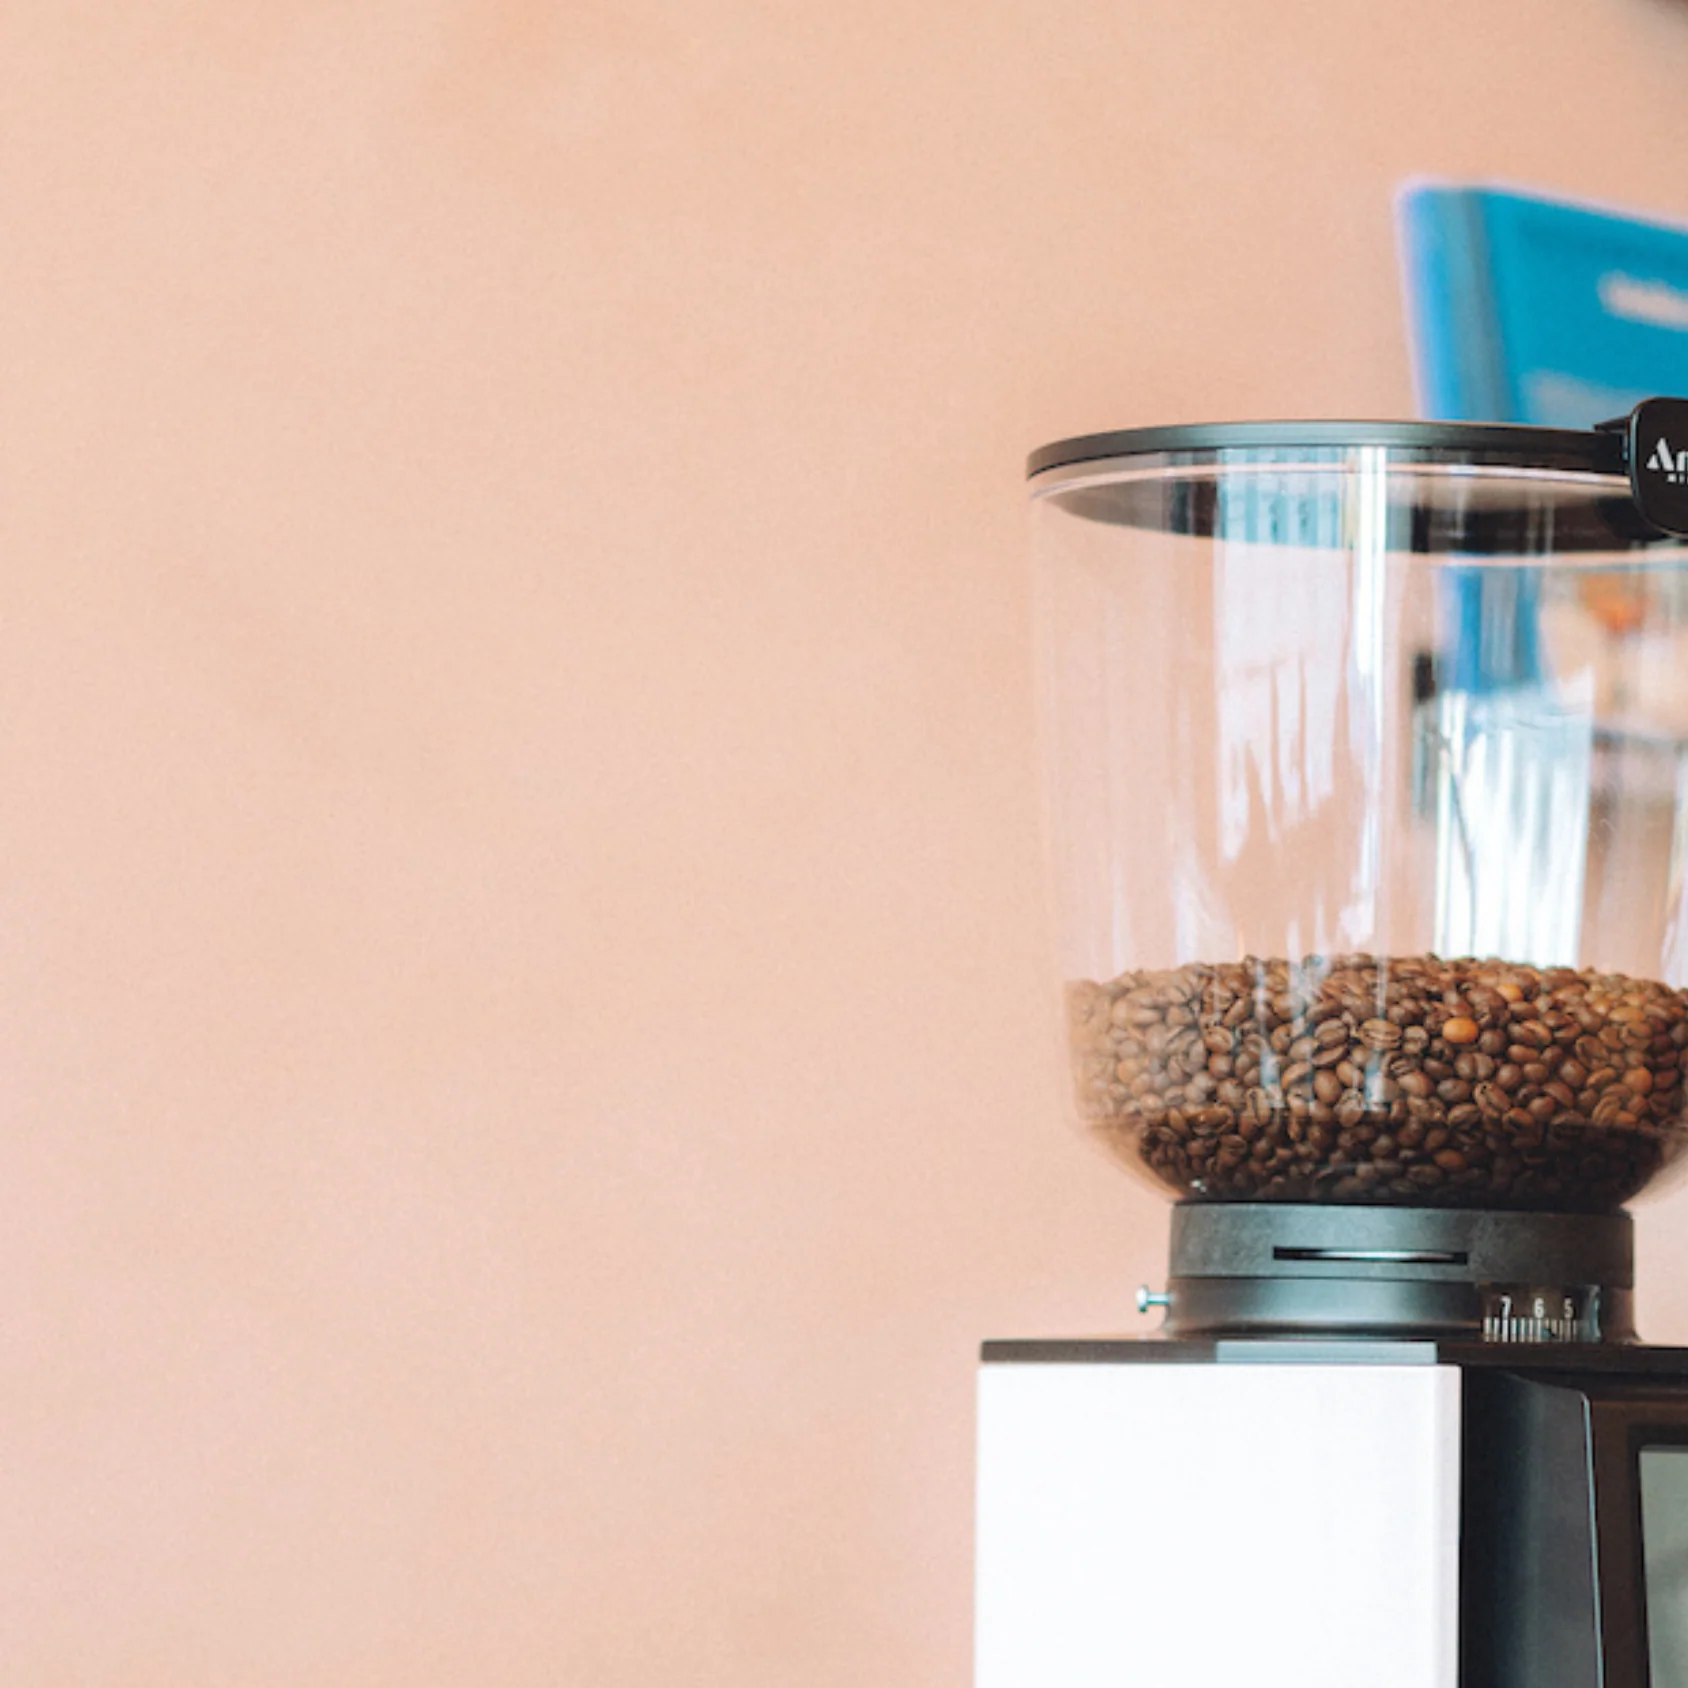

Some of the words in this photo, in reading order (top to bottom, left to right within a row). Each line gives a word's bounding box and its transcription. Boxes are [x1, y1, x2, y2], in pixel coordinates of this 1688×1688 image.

[1500, 1296, 1511, 1318] 7
[1533, 1298, 1544, 1319] 6
[1563, 1298, 1573, 1319] 5
